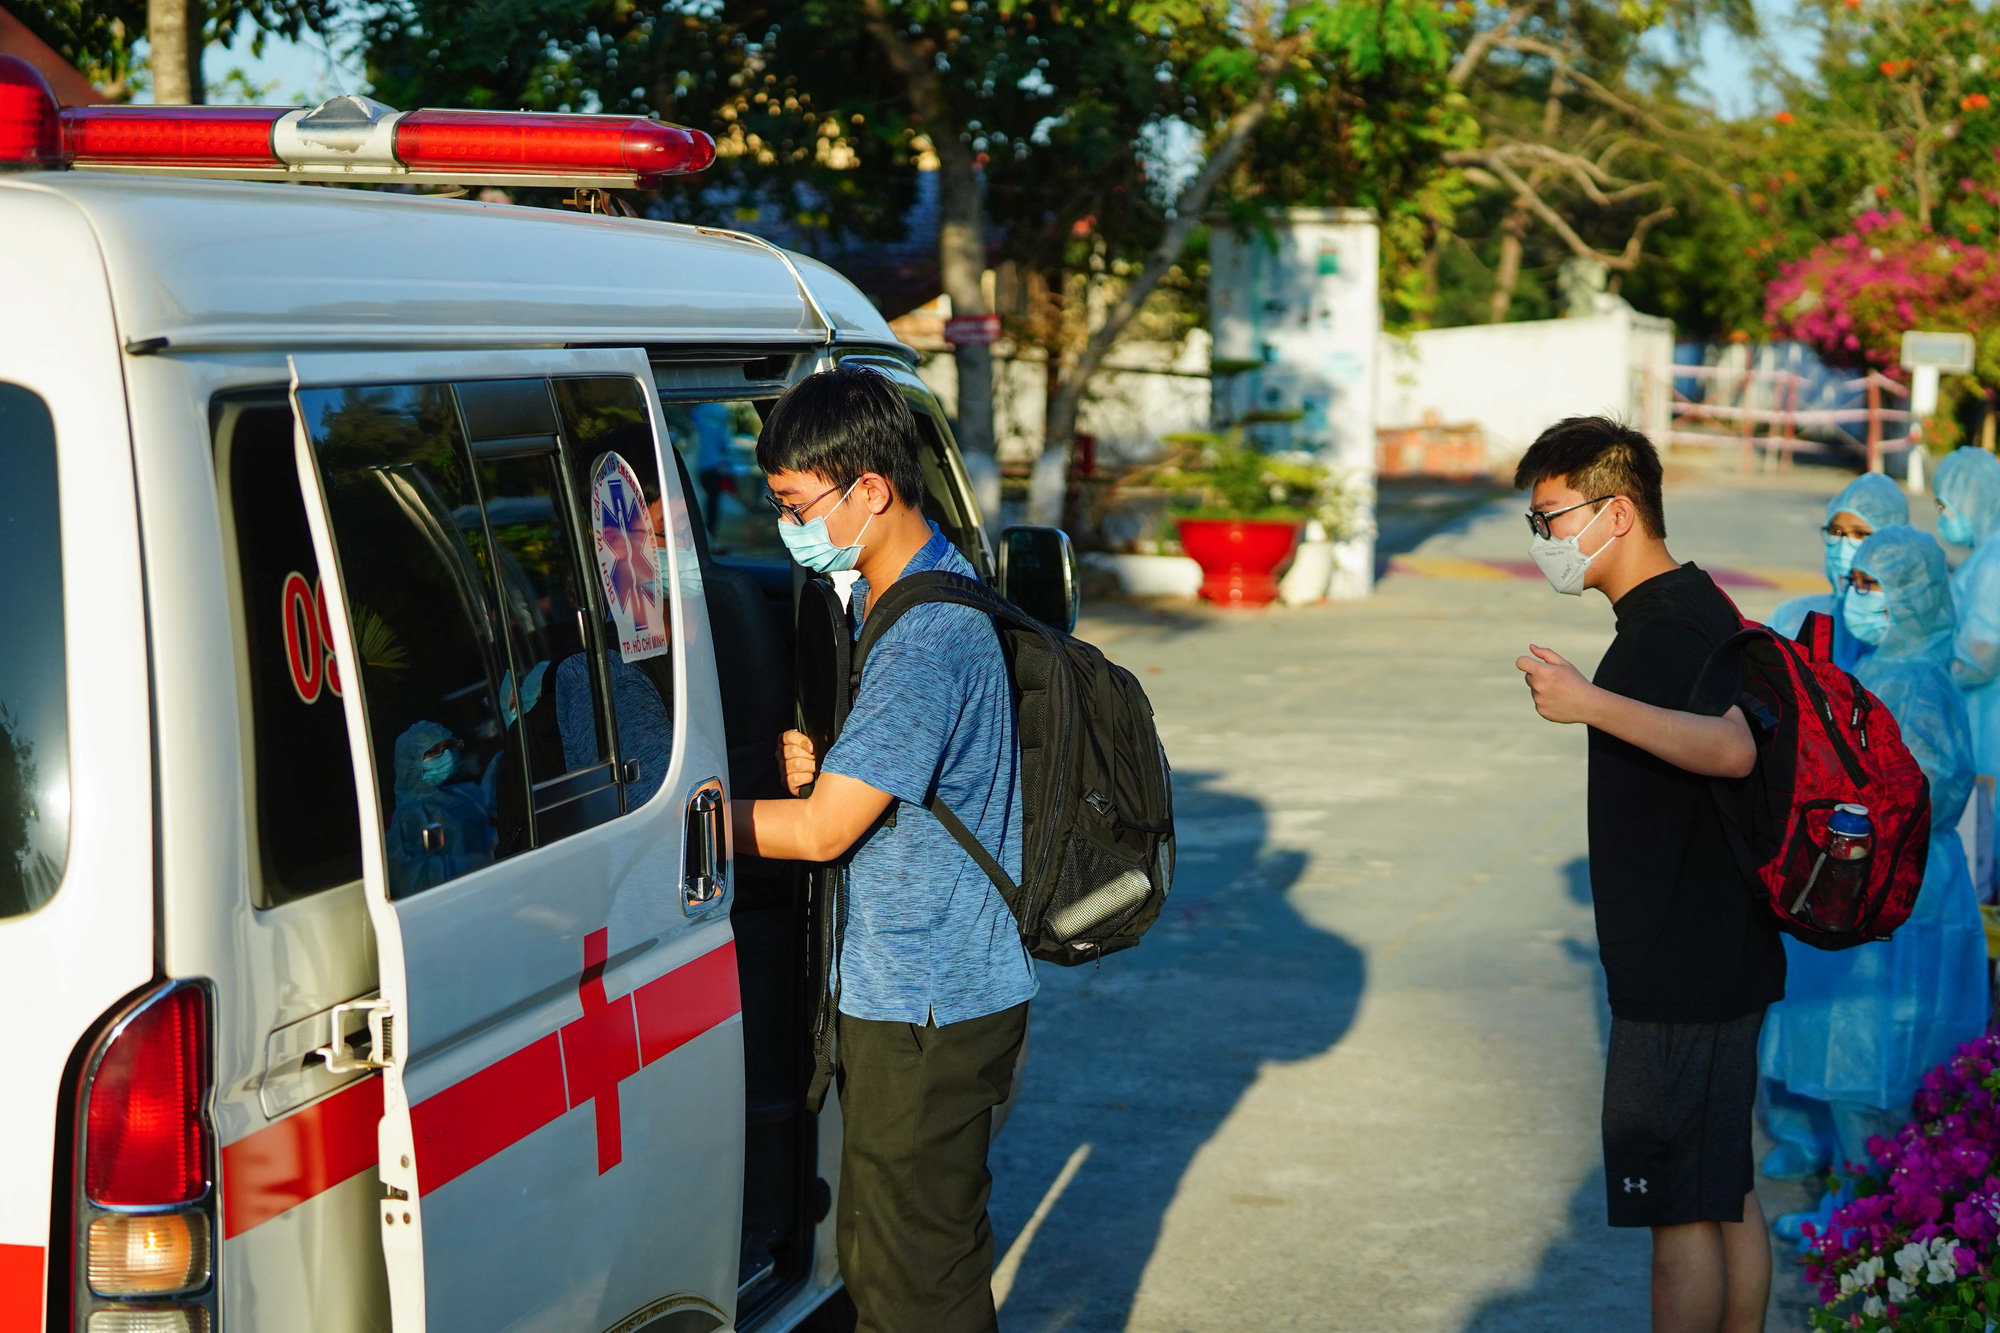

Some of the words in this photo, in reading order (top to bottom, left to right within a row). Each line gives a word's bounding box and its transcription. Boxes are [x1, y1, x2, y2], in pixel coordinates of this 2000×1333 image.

[617, 460, 649, 521] EMERGENCY
[648, 527, 662, 597] SERVICES
[651, 634, 666, 649] MINH
